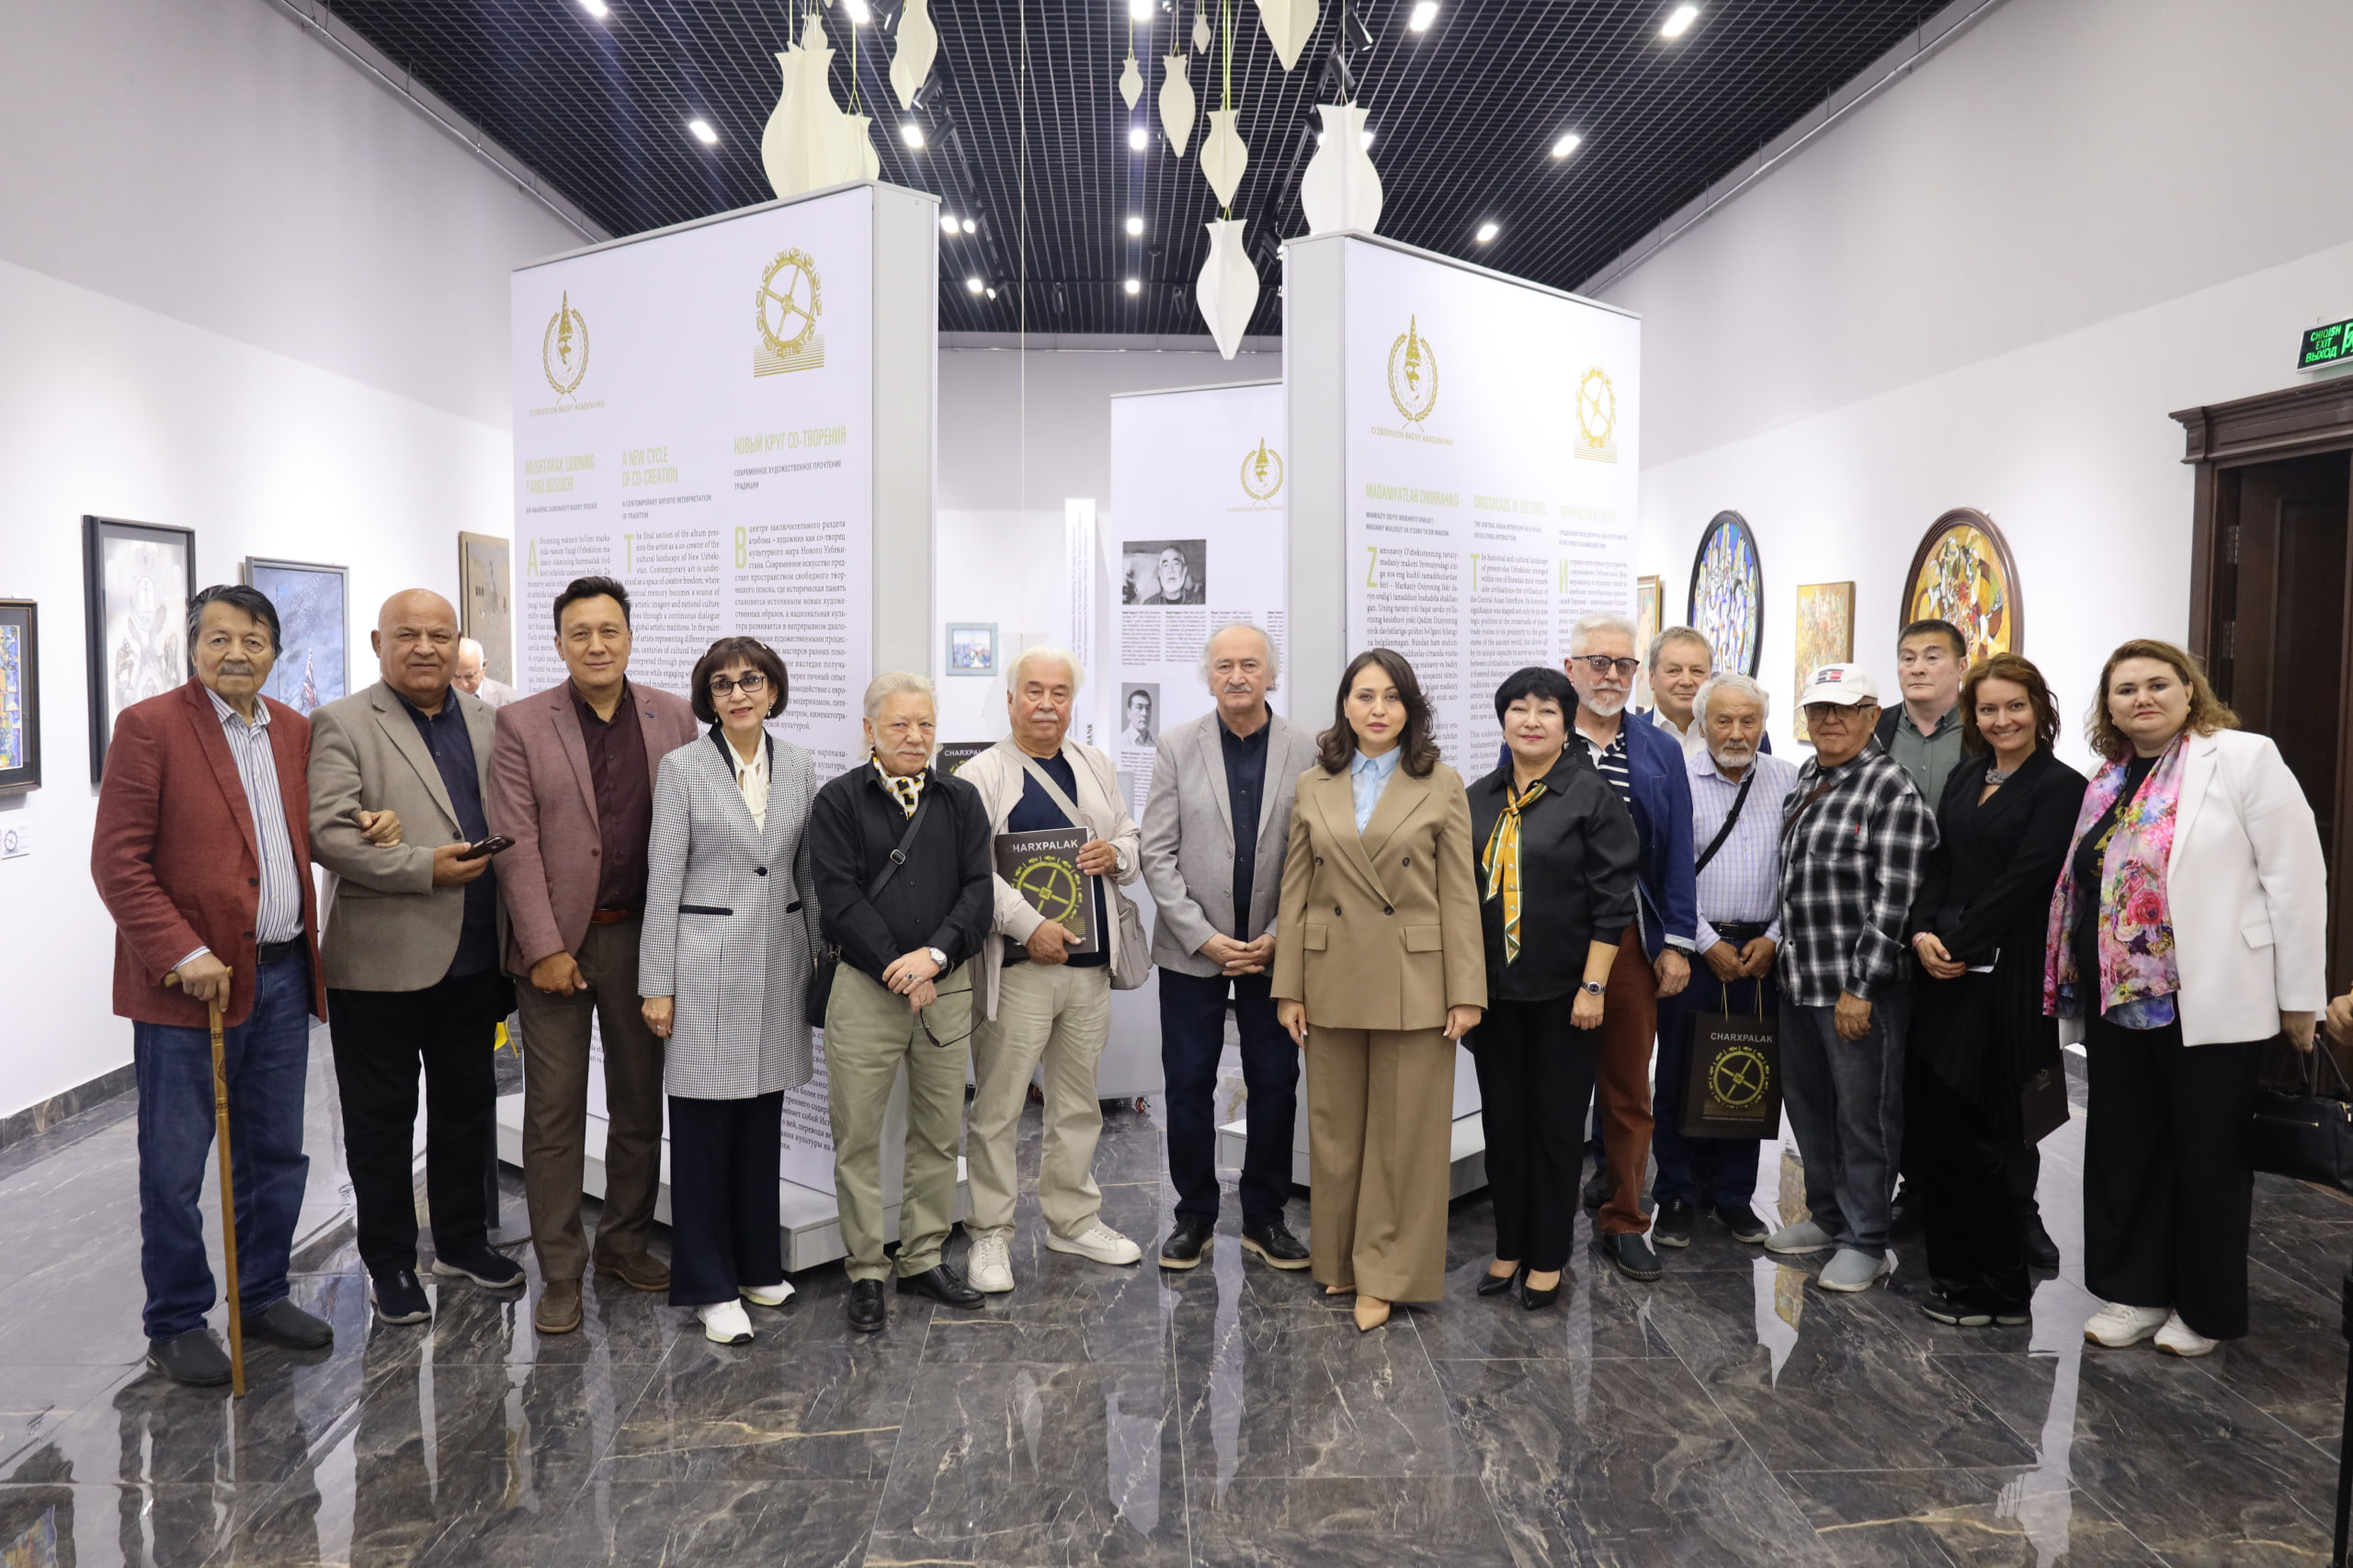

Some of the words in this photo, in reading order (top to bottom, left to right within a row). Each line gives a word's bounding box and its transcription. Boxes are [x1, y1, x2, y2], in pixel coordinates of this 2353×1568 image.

[2310, 324, 2342, 342] CHIQISH
[2315, 336, 2333, 350] EXIT
[2305, 345, 2338, 363] ВЫХОД
[734, 432, 763, 455] НОВЫЙ
[765, 433, 787, 452] КРУГ
[788, 426, 847, 449] СО-ТВОРЕНИЯ
[622, 449, 628, 467] A
[629, 449, 645, 466] NEW
[647, 447, 669, 464] CYCLE
[734, 467, 767, 477] СОВРЕМЕННОЕ
[768, 462, 812, 474] ХУДОЖЕСТВЕННОЕ
[813, 460, 842, 470] ПРОЧТЕНИЕ
[622, 471, 631, 487] OF
[632, 467, 678, 486] CO-CREATION
[734, 482, 759, 491] ТРАДИЦИИ
[1366, 483, 1418, 504] MADANIYATLAR
[655, 530, 673, 540] section
[674, 529, 680, 538] of
[681, 528, 689, 538] the
[690, 528, 707, 538] album
[748, 526, 768, 535] центре
[770, 522, 820, 532] заключительного
[822, 520, 847, 531] раздела
[816, 533, 846, 543] со-творец
[656, 553, 680, 564] landscape
[688, 553, 699, 562] New
[748, 549, 784, 559] культурного
[785, 549, 800, 558] мира
[801, 546, 823, 555] Нового
[650, 565, 686, 576] Contemporary
[766, 560, 801, 571] Современное
[751, 574, 794, 584] пространством
[795, 571, 829, 581] свободного
[648, 589, 667, 598] memory
[669, 587, 690, 597] becomes
[787, 585, 824, 596] историческая
[825, 585, 847, 593] память
[702, 597, 720, 607] culture
[698, 608, 720, 621] dialogue
[795, 660, 822, 669] наследие
[1711, 1032, 1773, 1043] CHARXPALAK
[802, 1112, 819, 1126] собой
[796, 1134, 823, 1148] культуры
